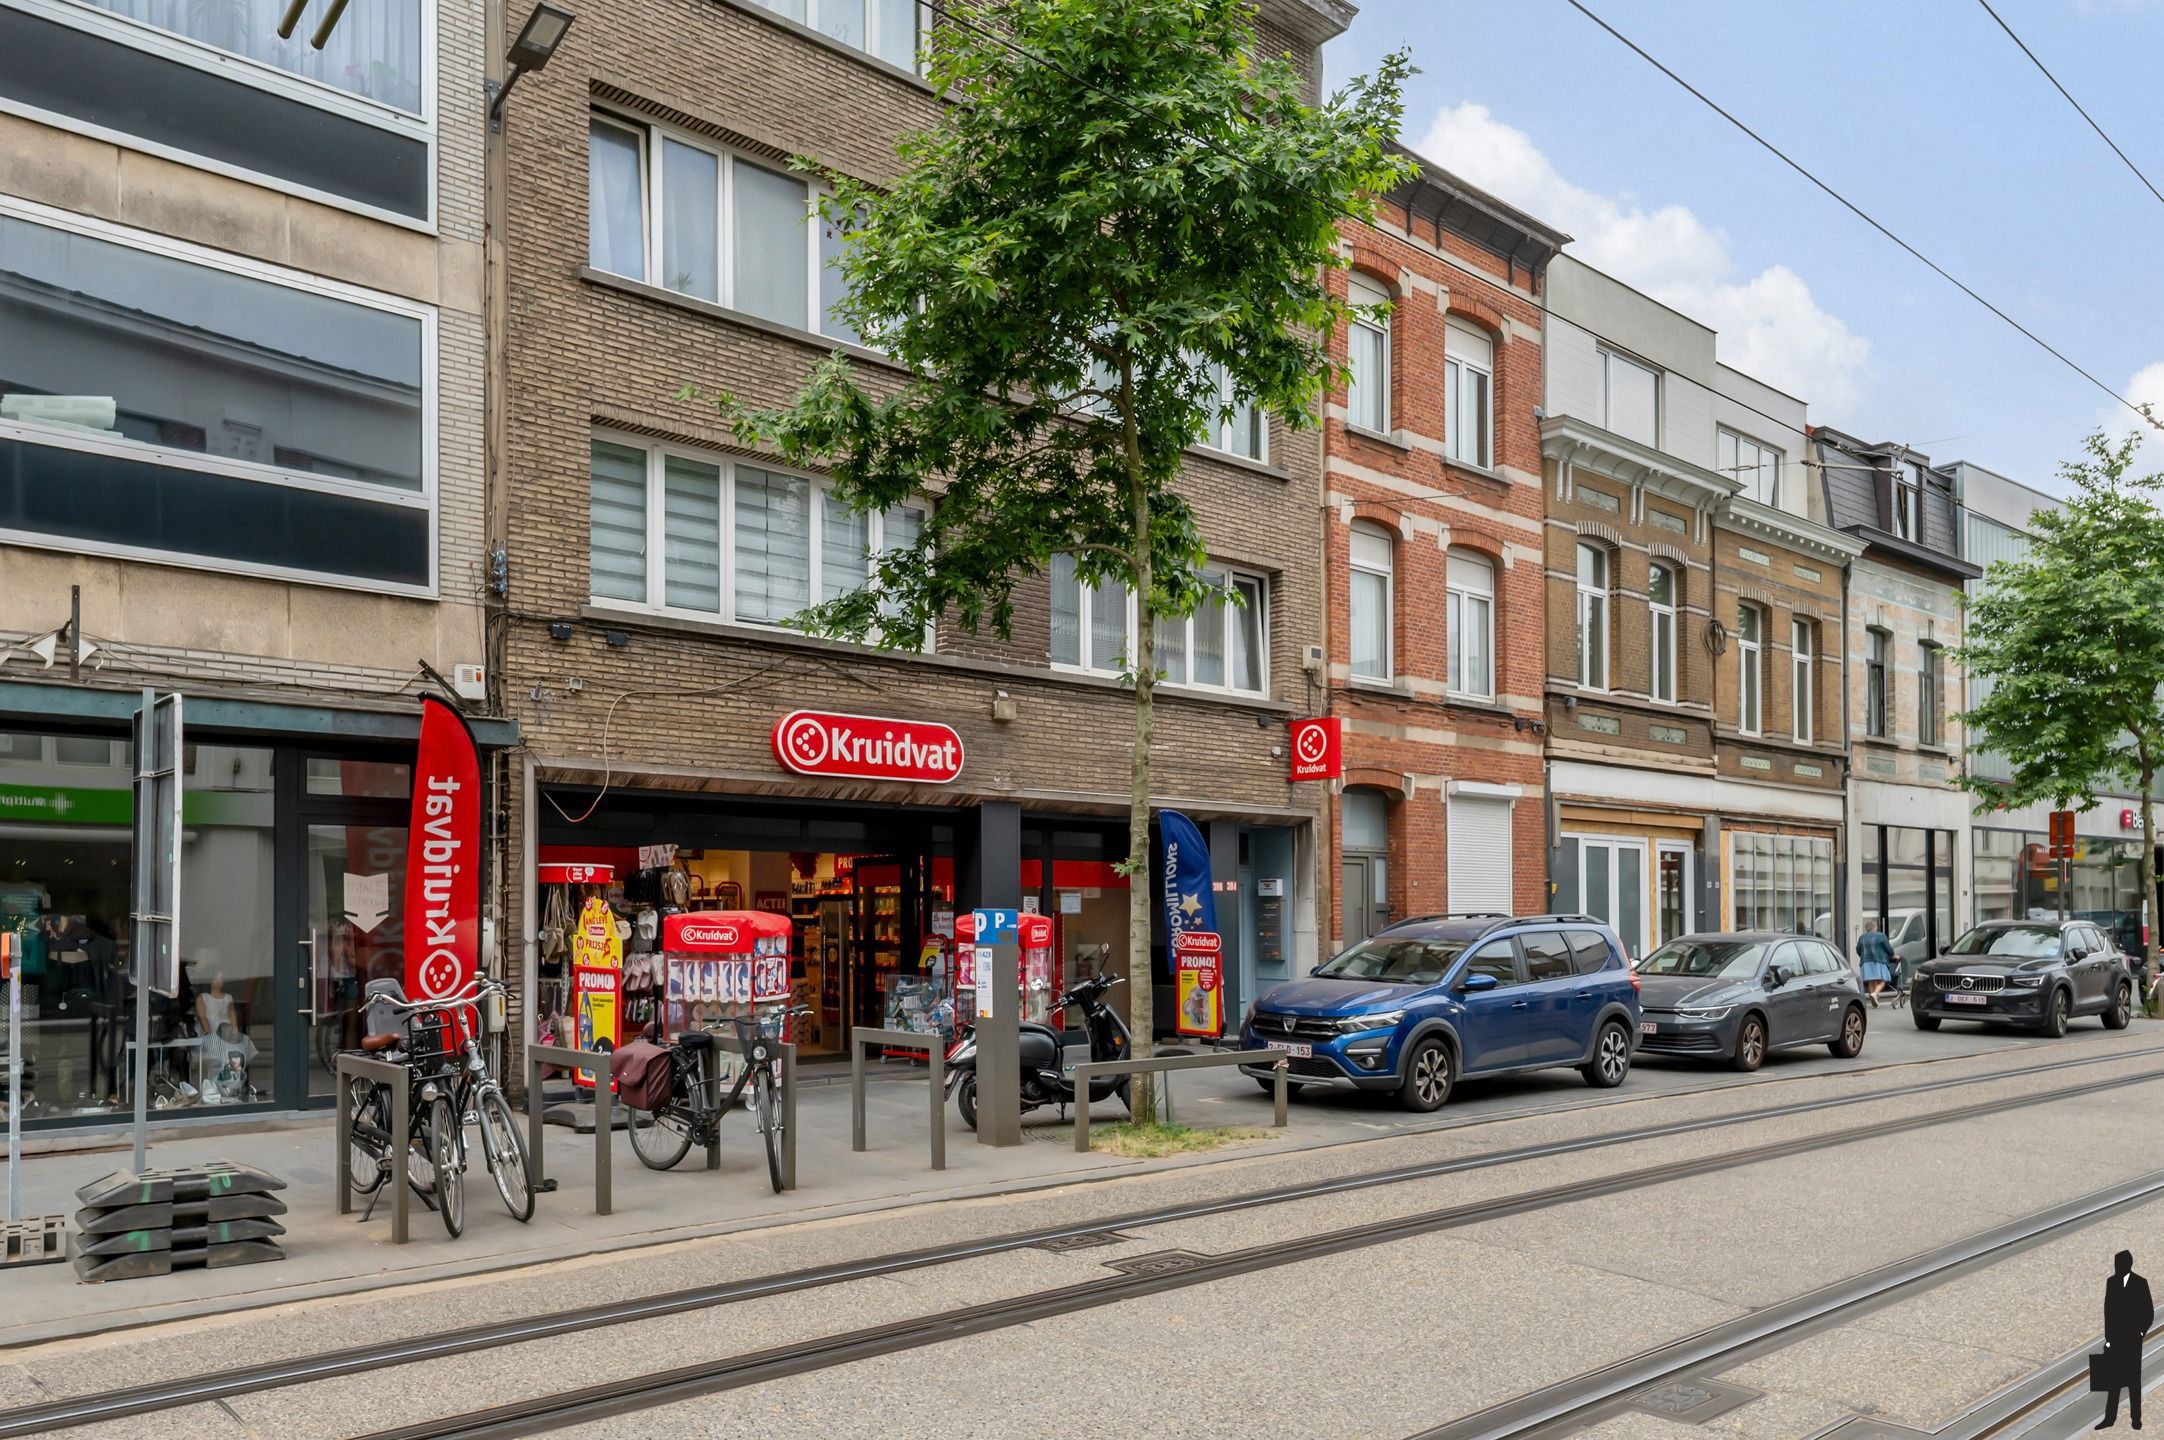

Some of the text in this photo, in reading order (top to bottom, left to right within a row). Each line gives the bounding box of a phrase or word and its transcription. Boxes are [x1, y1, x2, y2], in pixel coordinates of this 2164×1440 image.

[832, 728, 957, 771] Kruidvat
[1297, 763, 1327, 775] Kruidvat
[995, 912, 1006, 929] P
[696, 930, 733, 941] Kruidvat
[1187, 936, 1218, 948] Kruidvat
[1181, 956, 1216, 969] PROMO!
